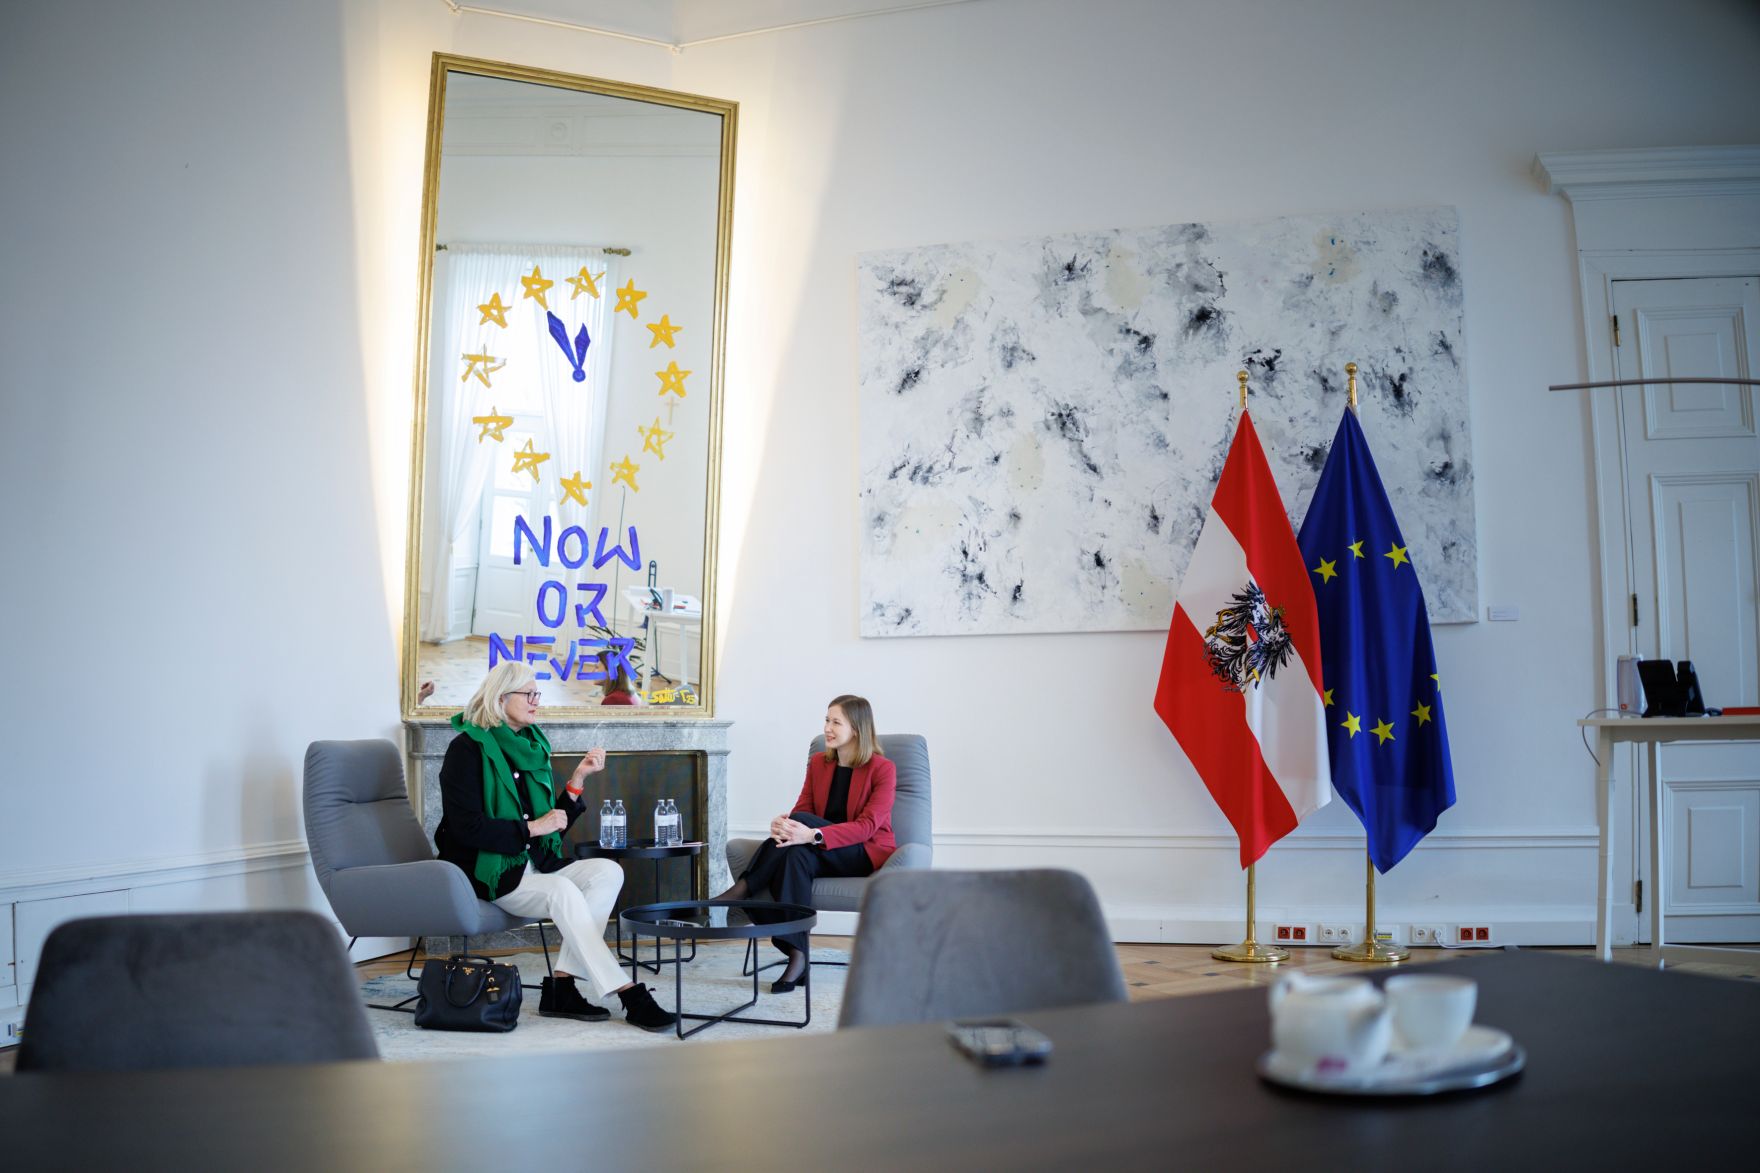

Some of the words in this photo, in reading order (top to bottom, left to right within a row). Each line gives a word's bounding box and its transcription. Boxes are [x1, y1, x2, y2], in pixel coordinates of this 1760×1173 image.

[513, 514, 642, 571] NOW
[536, 580, 608, 628] OR
[488, 632, 638, 681] NEVER
